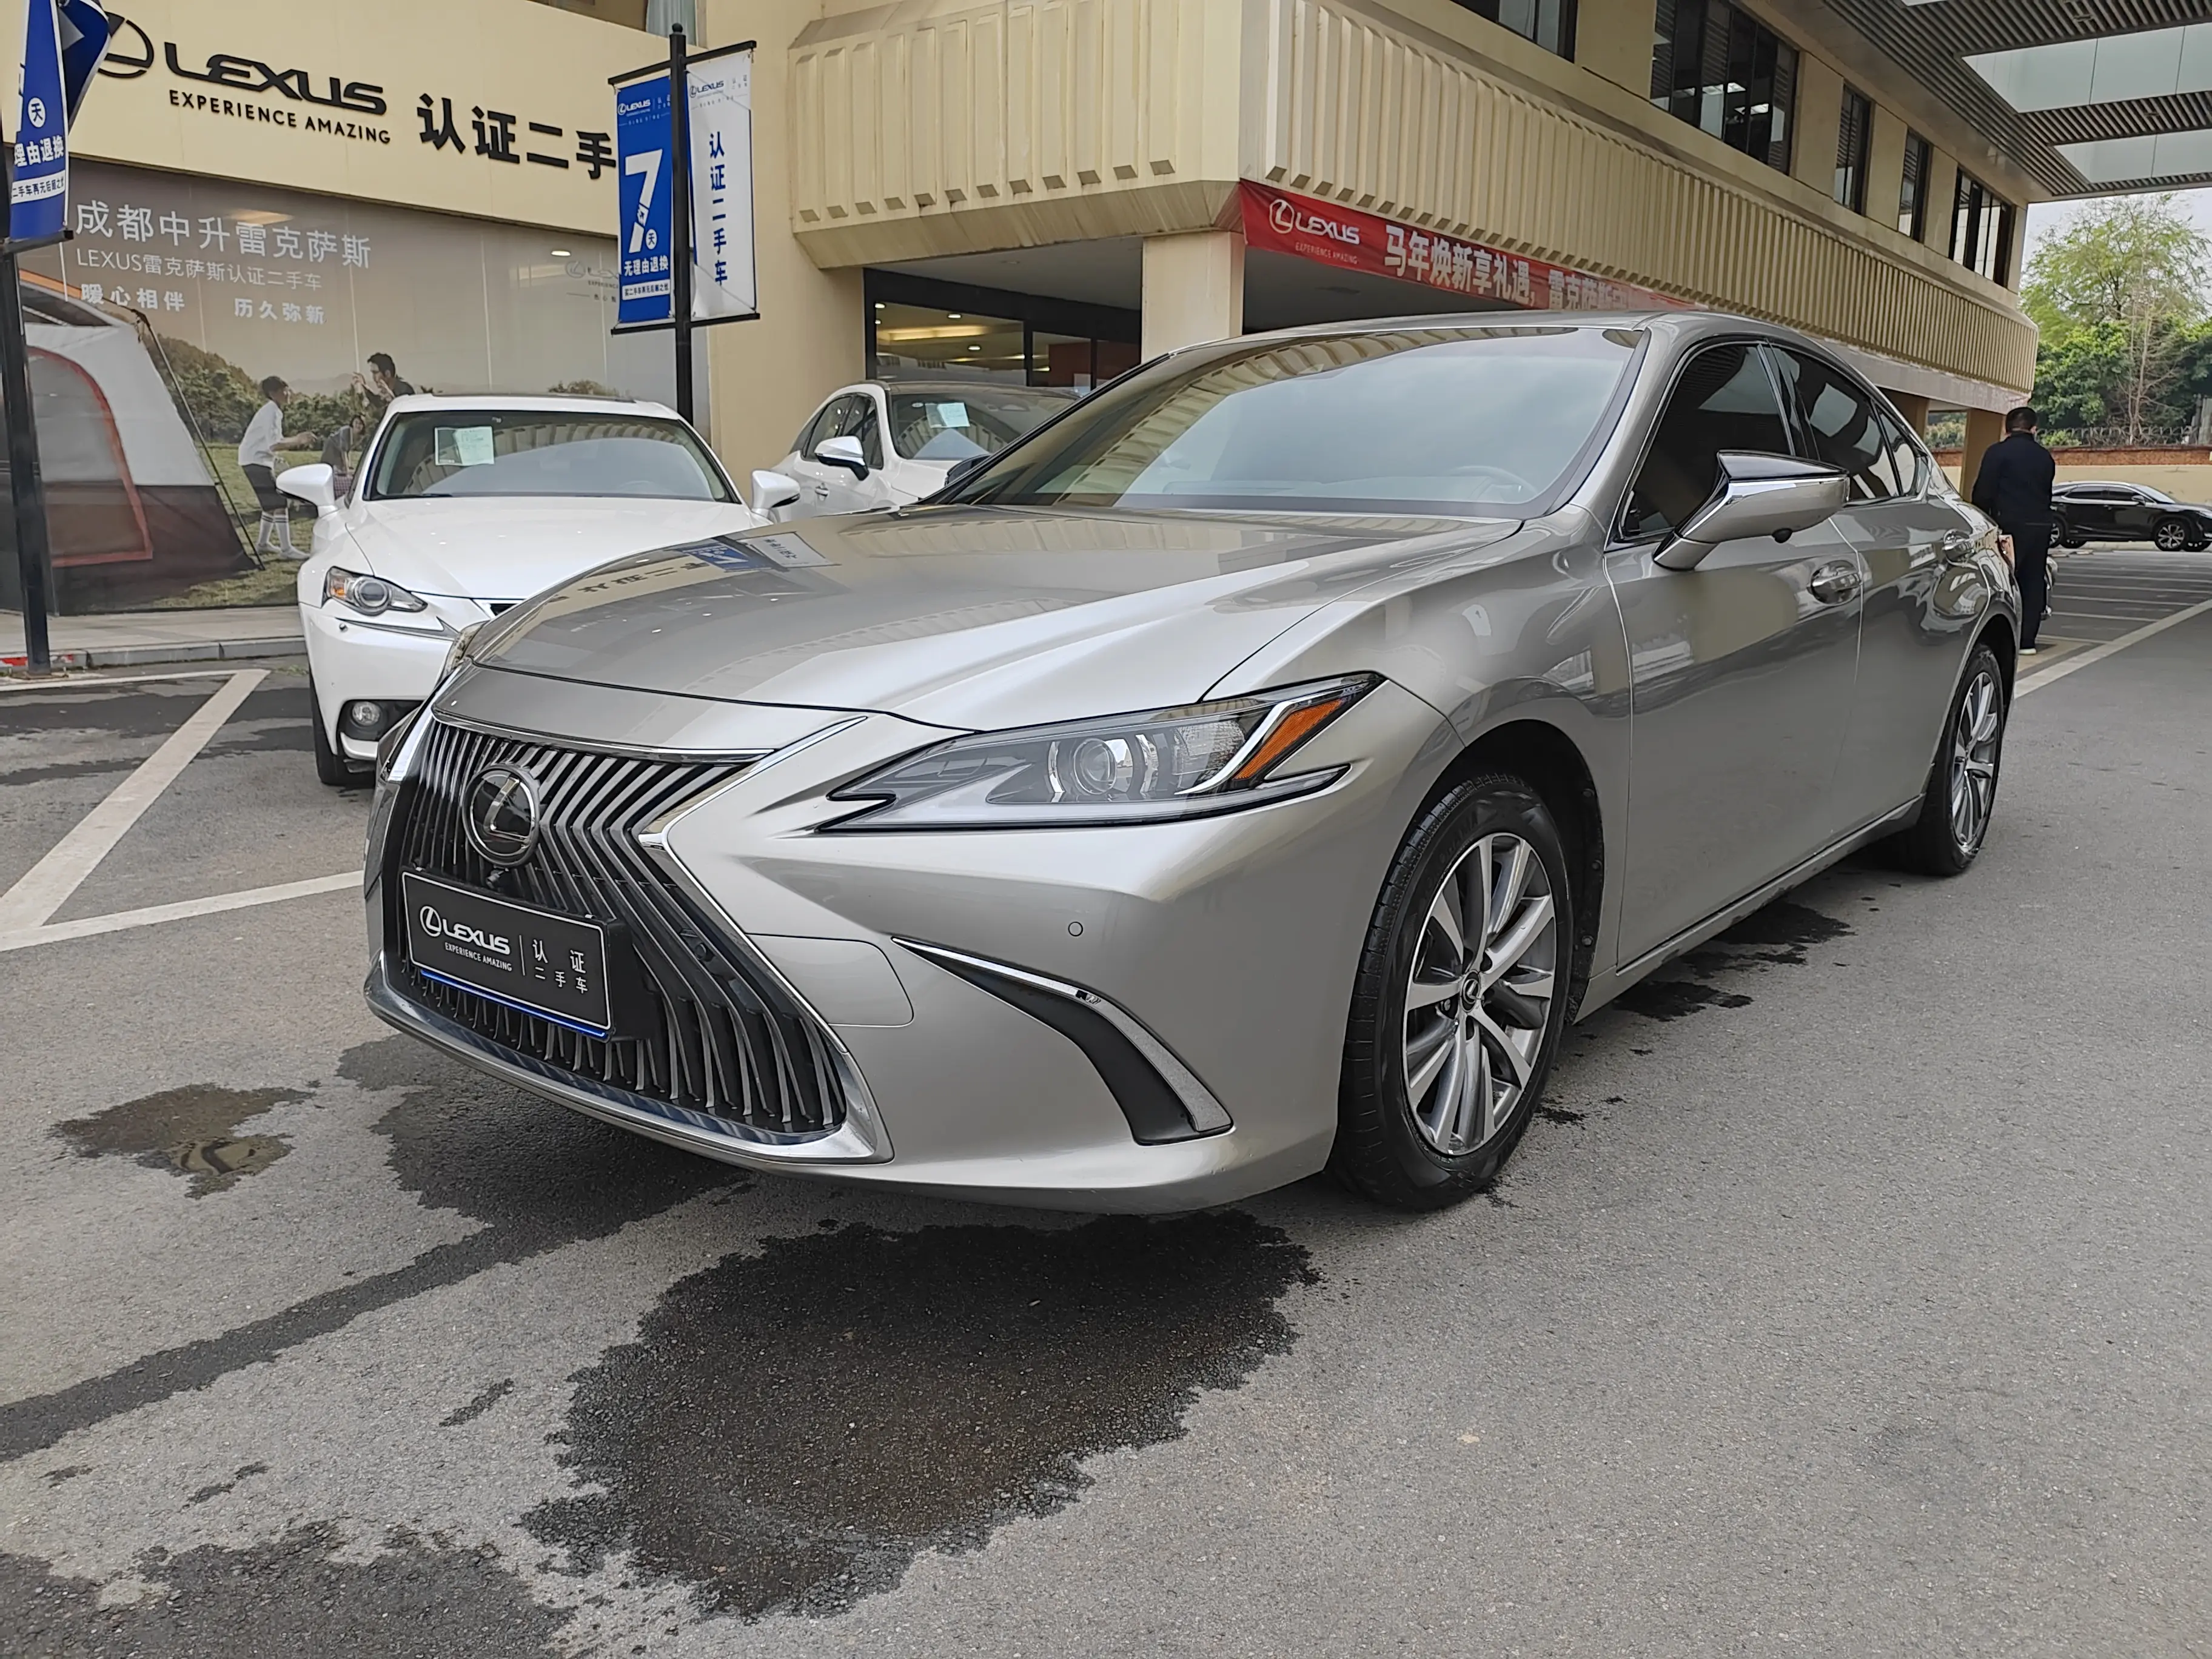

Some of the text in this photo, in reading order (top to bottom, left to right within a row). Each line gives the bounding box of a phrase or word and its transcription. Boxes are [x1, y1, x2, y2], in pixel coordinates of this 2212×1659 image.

[164, 42, 387, 115] LEXUS
[169, 90, 391, 144] EXPERIENCE AMAZING
[417, 93, 616, 179] 认证二手
[625, 149, 663, 253] 7
[709, 131, 728, 286] 认证二手车
[75, 199, 372, 269] 成都中升雷克萨斯
[1295, 212, 1359, 245] LEXUS
[623, 255, 669, 276] 无理由退换
[1295, 242, 1358, 265] EXPERIENCE AMAZING
[80, 283, 325, 325] 暖心相伴 历久弥新
[443, 919, 510, 955] LEXUS
[444, 942, 512, 971] EXPERIENCE AMAZING
[535, 967, 588, 994] 二手车
